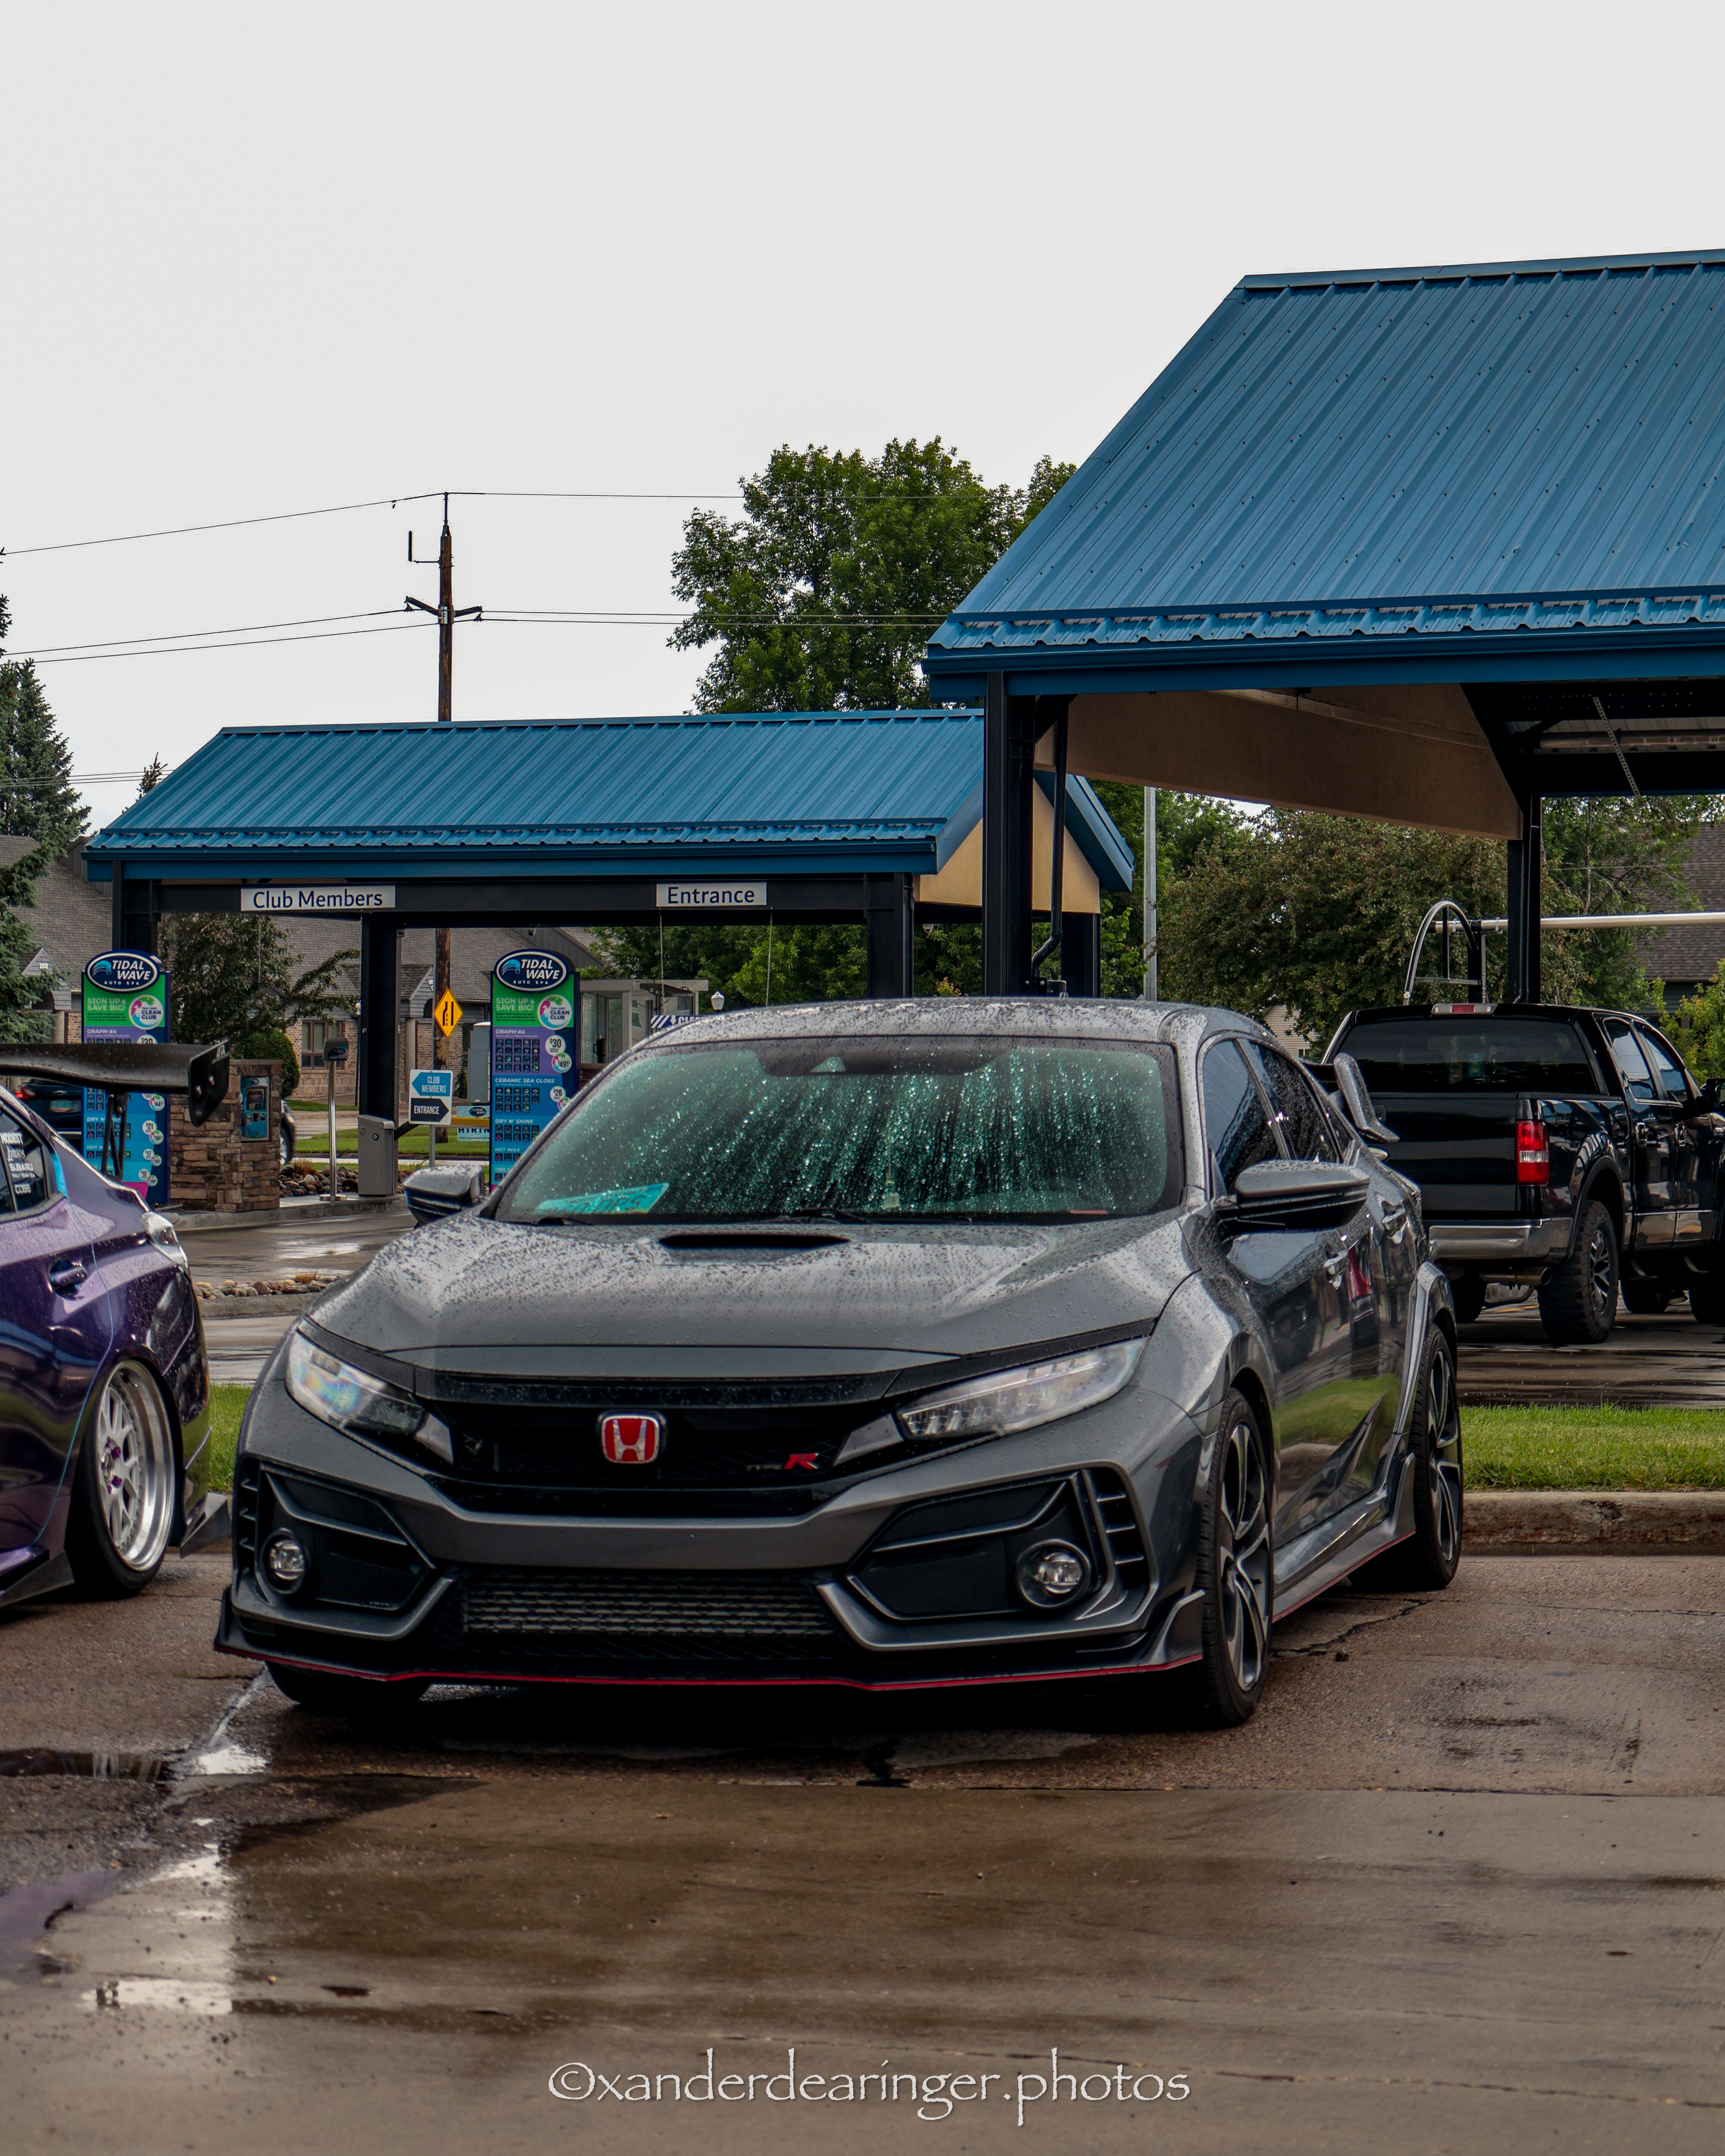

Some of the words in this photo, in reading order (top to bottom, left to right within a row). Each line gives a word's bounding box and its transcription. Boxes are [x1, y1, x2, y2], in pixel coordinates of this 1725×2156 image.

[253, 890, 293, 909] Club
[299, 888, 383, 907] Members
[668, 887, 755, 904] Entrance
[112, 960, 144, 970] TIDAL
[521, 959, 553, 969] TIDAL
[117, 970, 151, 980] WAVE
[526, 969, 560, 980] WAVE
[550, 1038, 561, 1048] $30
[427, 1076, 440, 1084] CLUB
[422, 1084, 447, 1093] MEMBERS
[414, 1106, 440, 1115] ENTRANCE
[9, 1163, 34, 1172] SUBARU
